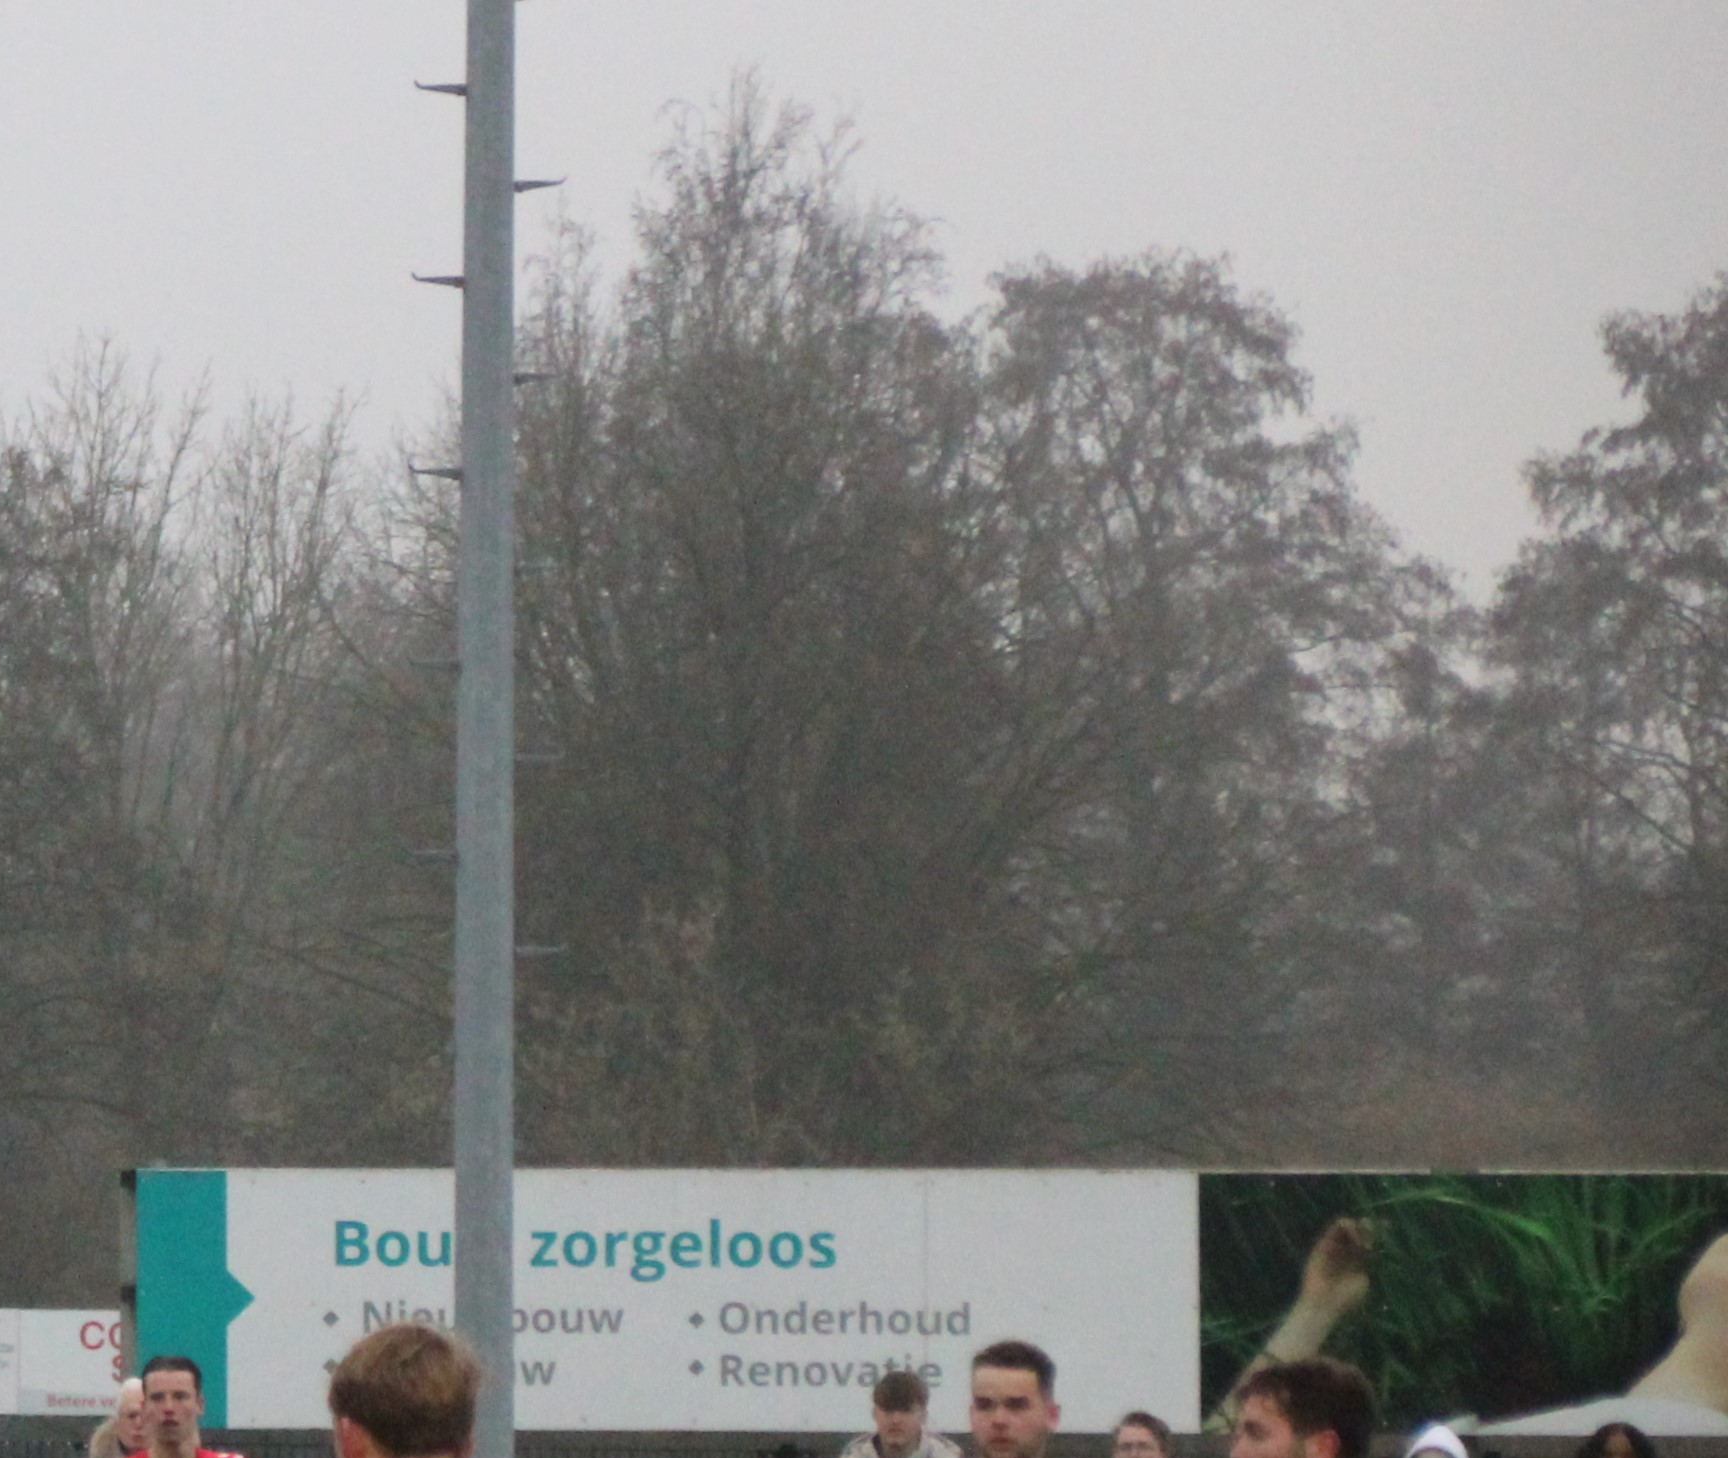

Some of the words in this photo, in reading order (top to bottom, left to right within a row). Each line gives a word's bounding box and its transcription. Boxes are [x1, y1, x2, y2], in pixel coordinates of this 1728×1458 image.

[333, 1219, 455, 1268] Bou
[529, 1219, 837, 1283] zorgeloos
[719, 1302, 971, 1336] Onderhoud
